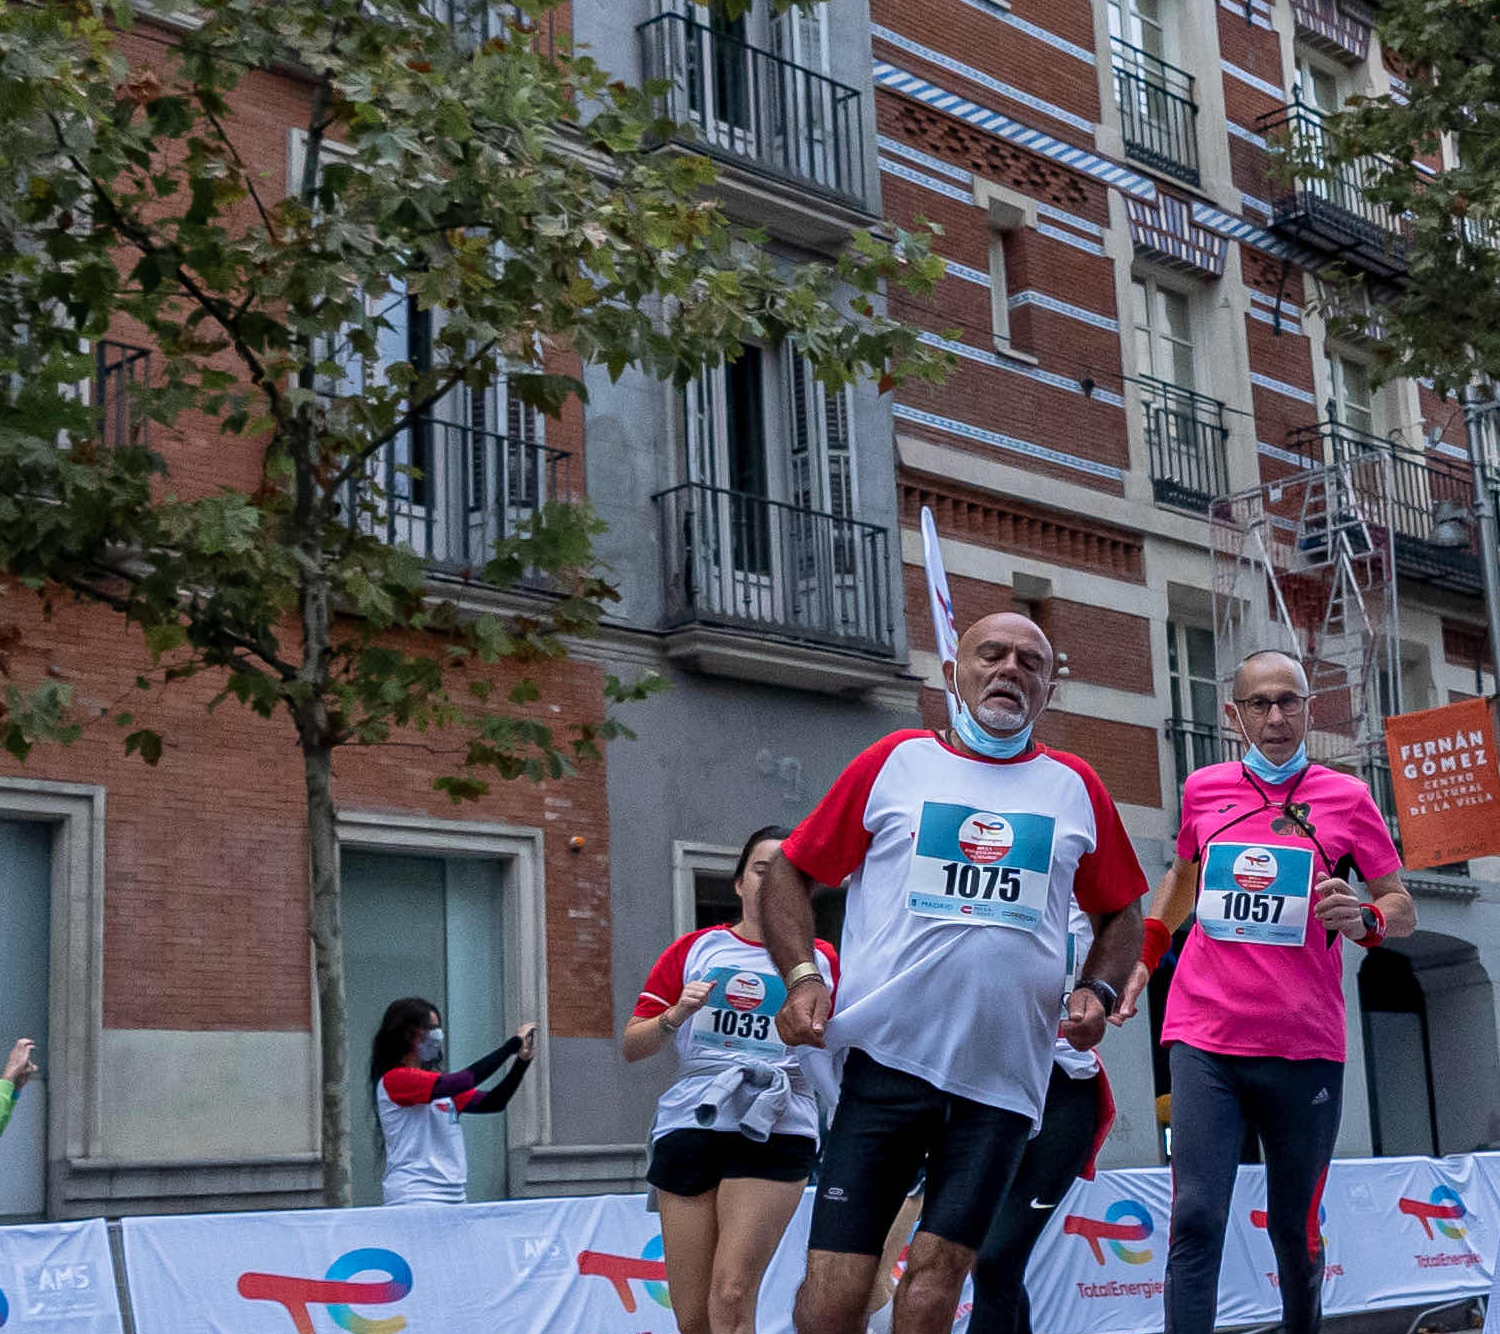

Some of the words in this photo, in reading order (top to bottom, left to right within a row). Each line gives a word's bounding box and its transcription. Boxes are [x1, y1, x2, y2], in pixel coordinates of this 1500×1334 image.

[1400, 729, 1484, 762] FERNÁN
[1403, 749, 1488, 780] GÓMEZ
[942, 862, 1021, 903] 1075
[1221, 891, 1285, 924] 1057
[711, 1008, 771, 1041] 1033
